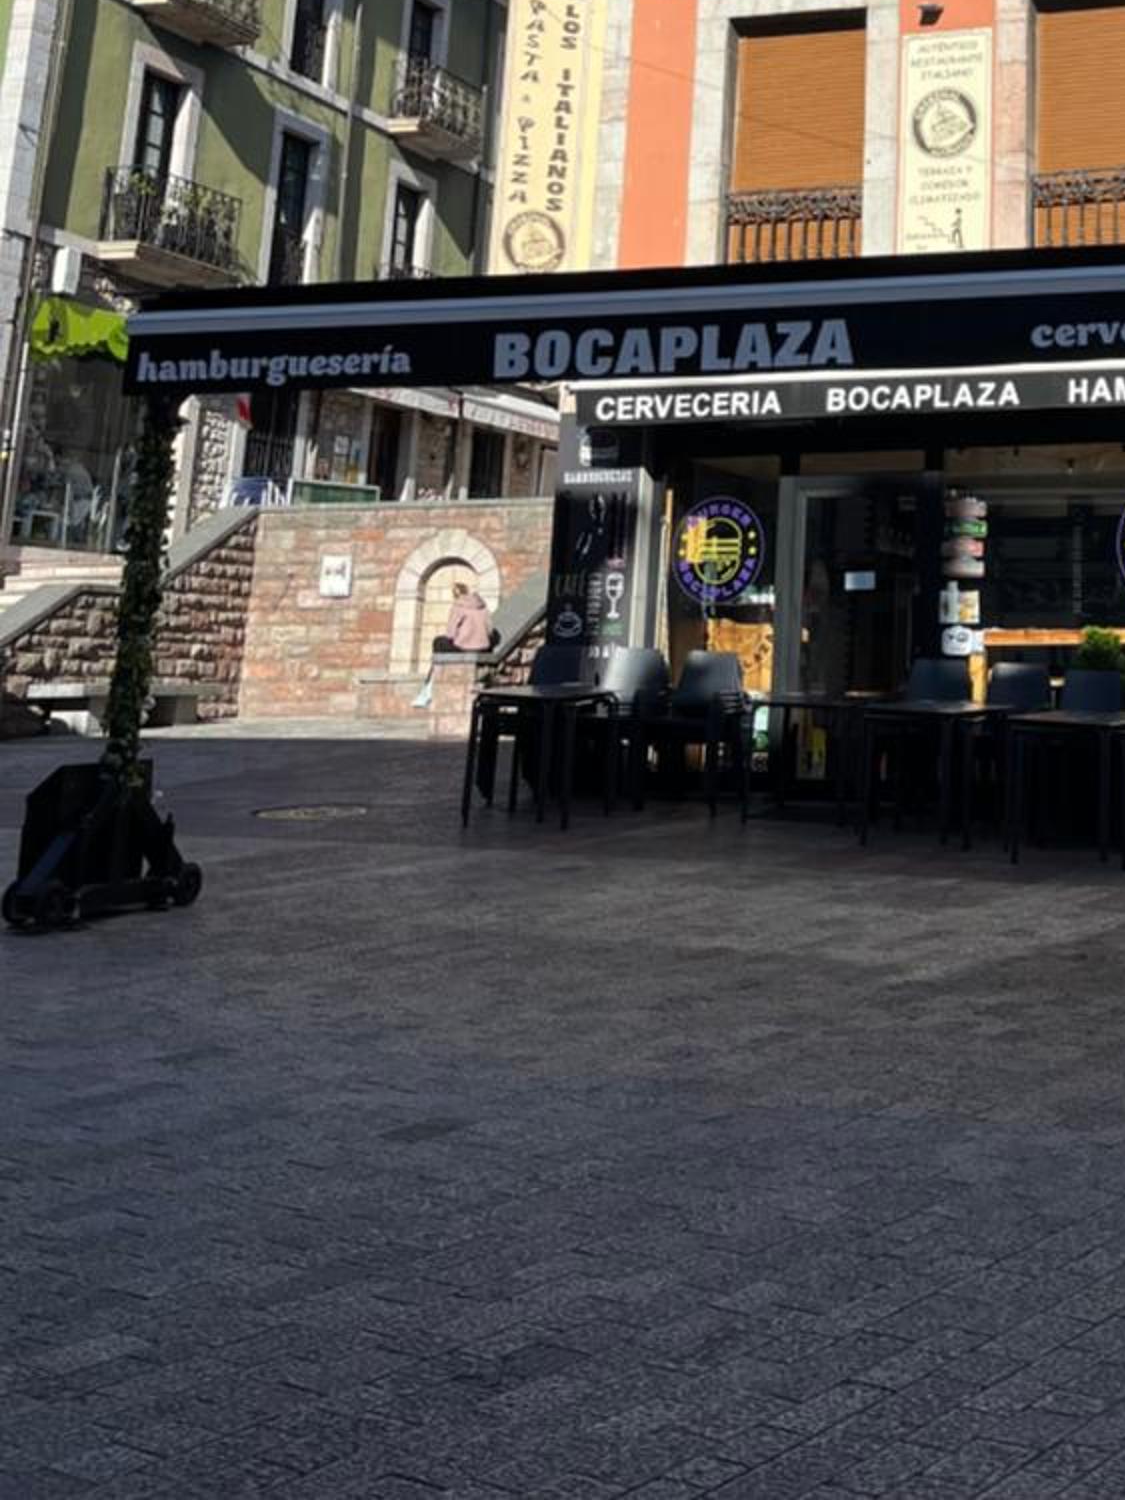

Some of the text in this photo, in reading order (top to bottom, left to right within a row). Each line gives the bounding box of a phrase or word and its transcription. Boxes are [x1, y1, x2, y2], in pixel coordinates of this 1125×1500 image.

[546, 4, 580, 212] LOS ITALIANOS
[508, 116, 535, 204] PIZZA
[137, 344, 412, 387] hamburguesería
[492, 318, 855, 379] BOCAPLAZA
[595, 390, 782, 422] CERVECERIA
[825, 381, 1020, 413] BOCAPLAZA
